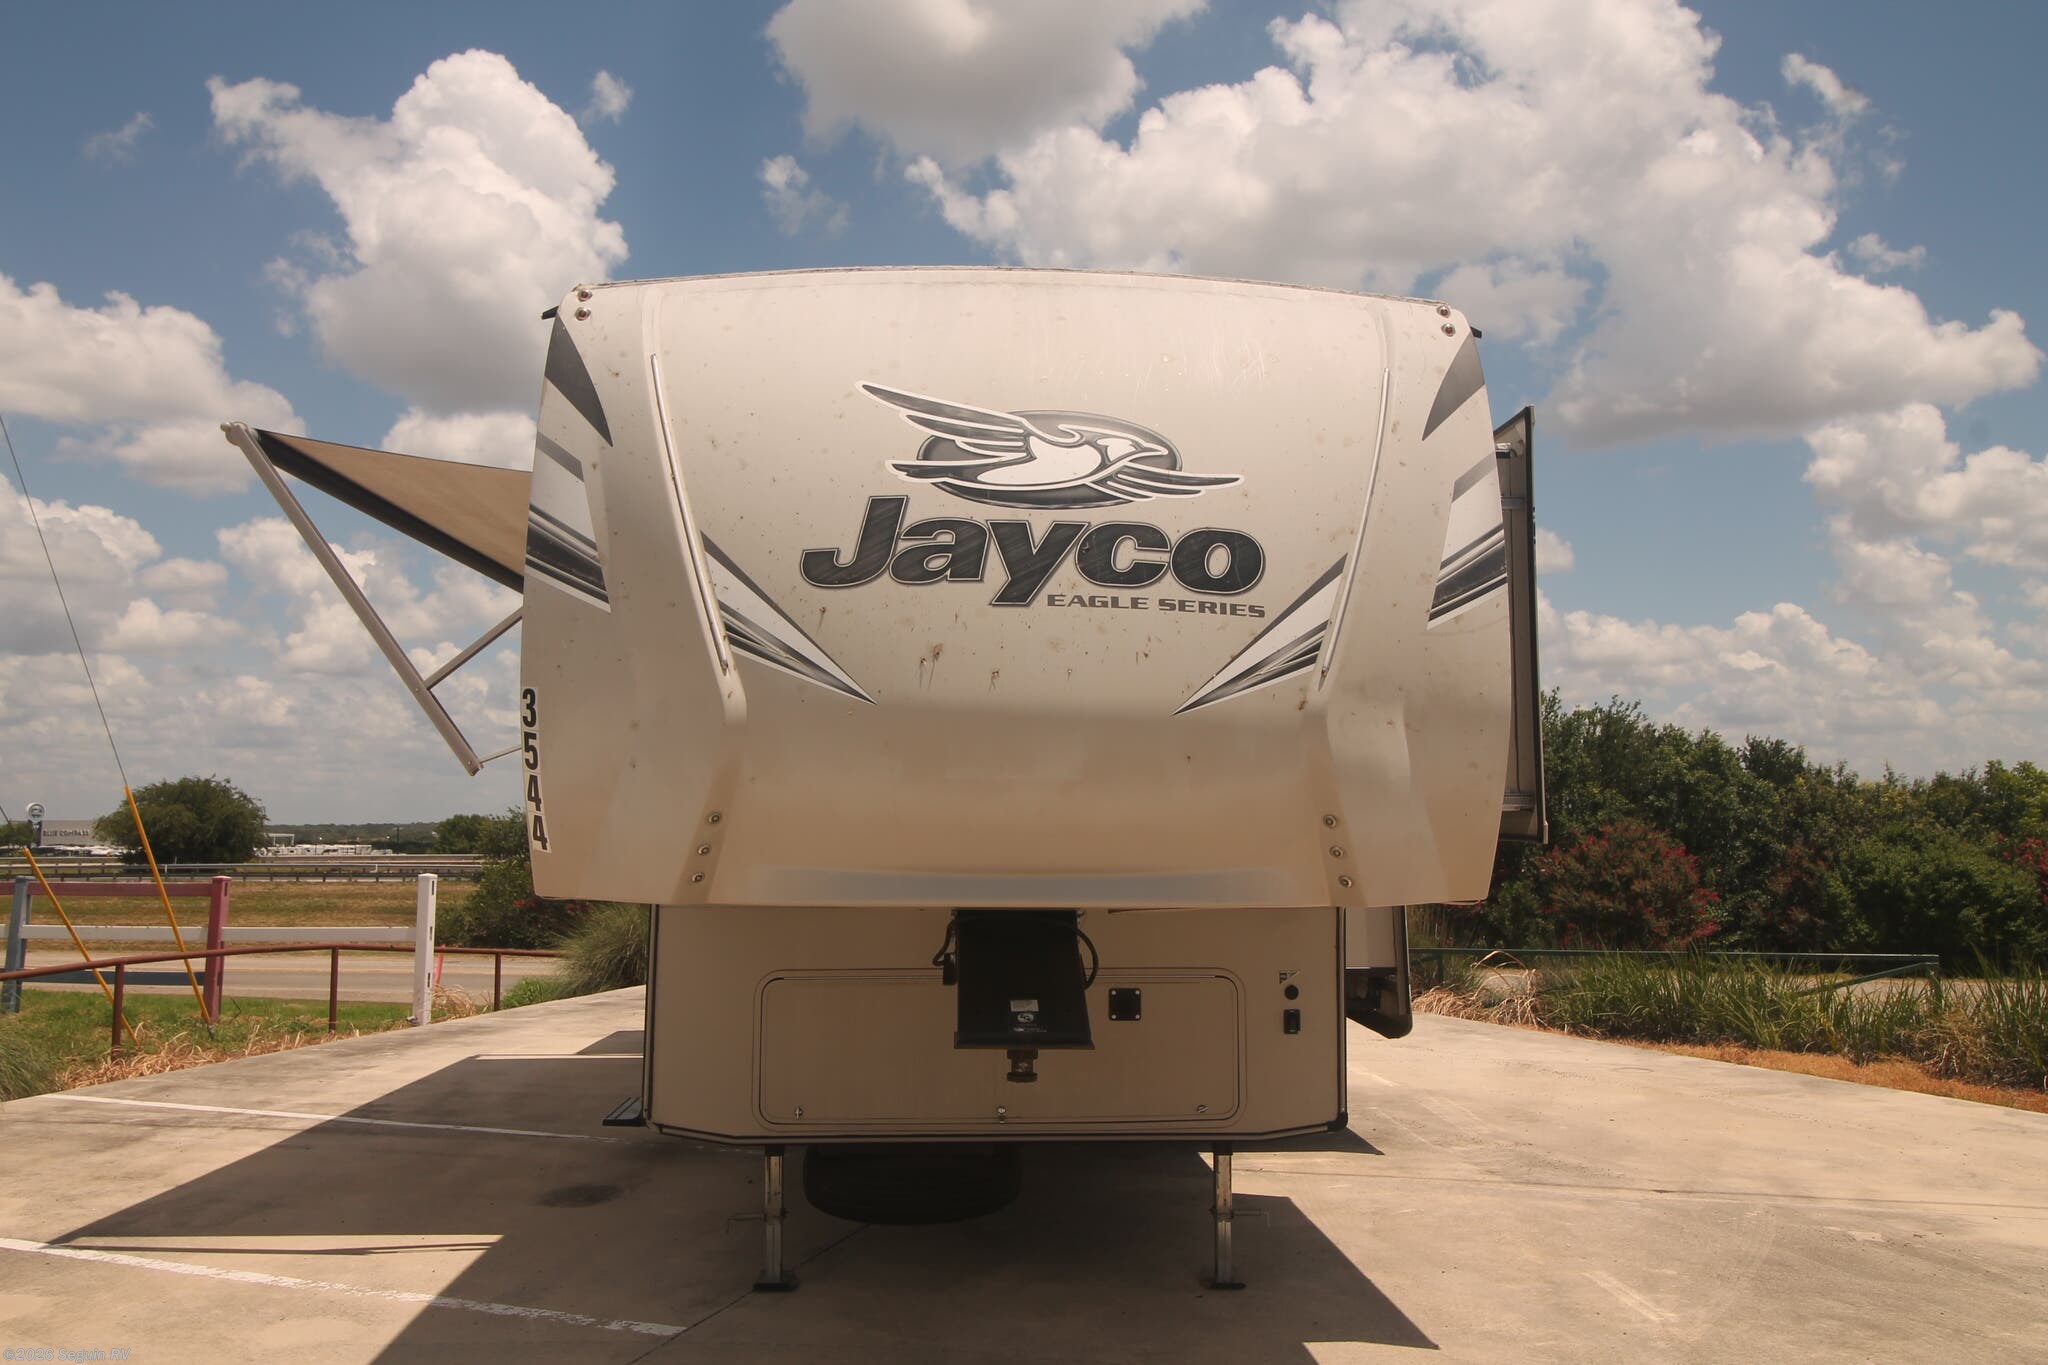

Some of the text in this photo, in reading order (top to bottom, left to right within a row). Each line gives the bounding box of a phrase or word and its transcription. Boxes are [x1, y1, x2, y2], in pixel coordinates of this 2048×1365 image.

[800, 495, 1266, 607] Jayco
[1047, 594, 1265, 618] EAGLE SERIES
[522, 688, 548, 851] 3544
